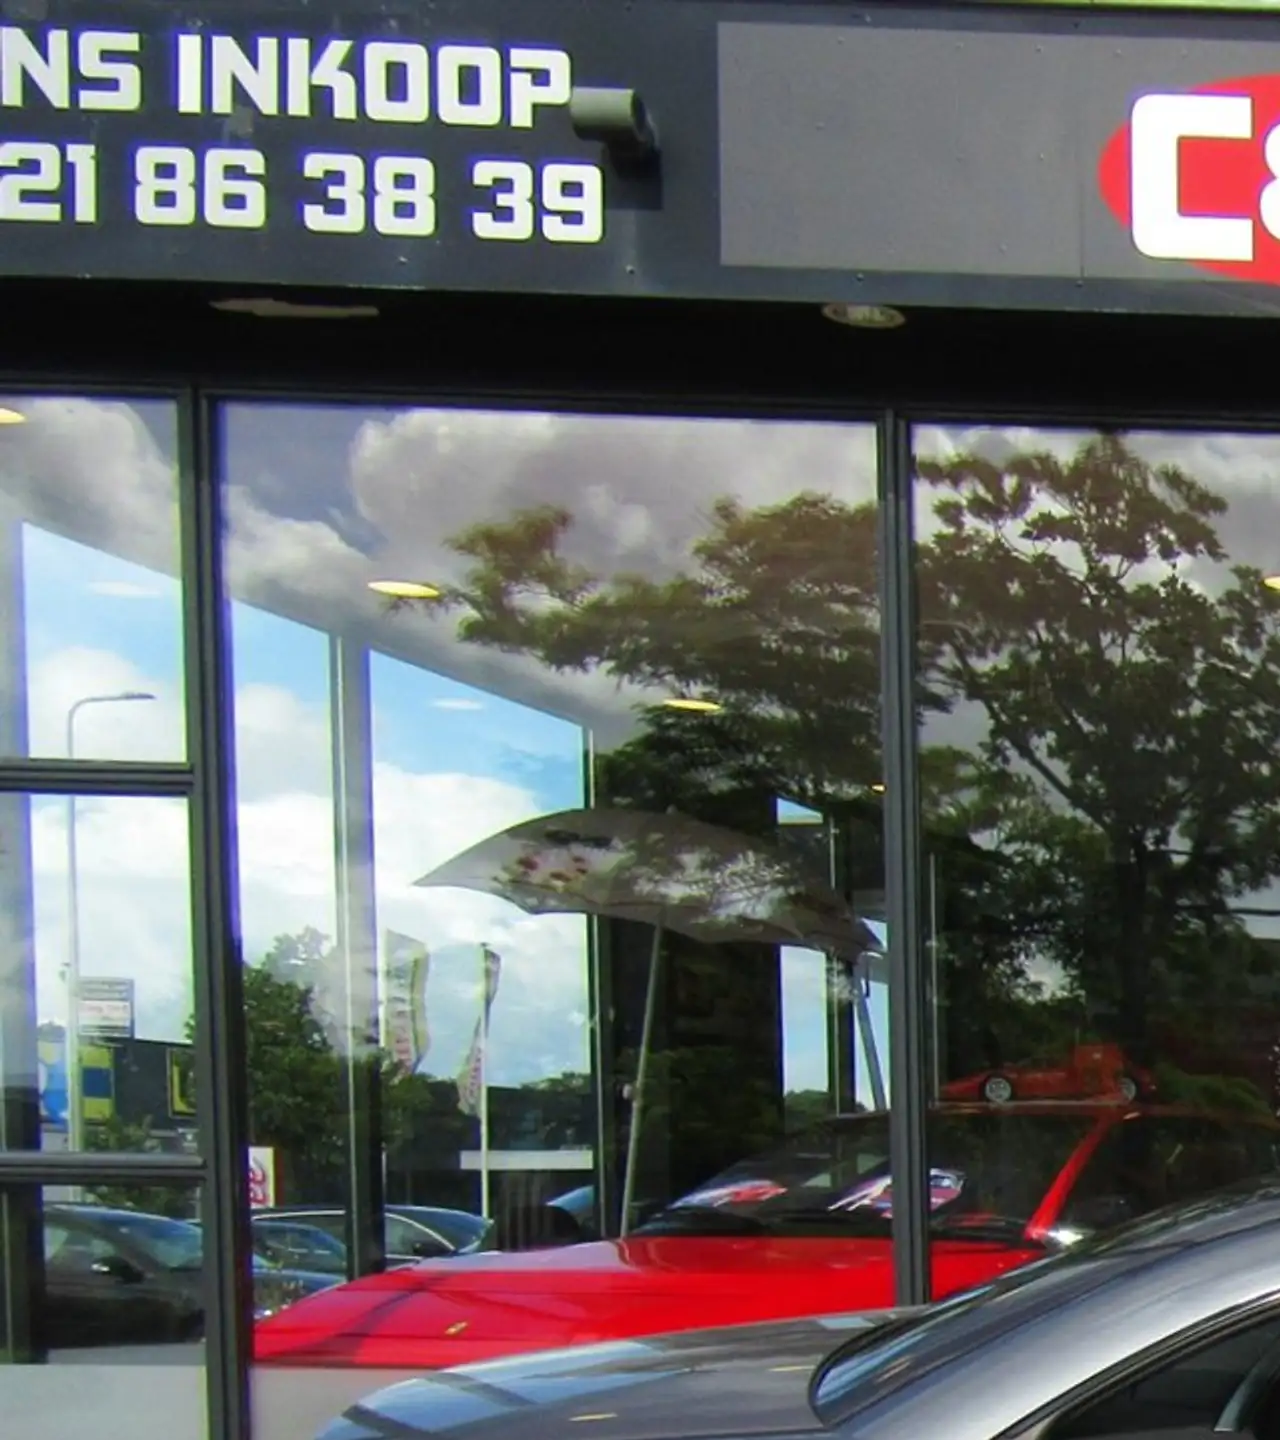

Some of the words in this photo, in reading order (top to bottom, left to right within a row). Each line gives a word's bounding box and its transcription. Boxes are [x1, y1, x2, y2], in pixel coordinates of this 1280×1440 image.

[0, 26, 140, 111] NS
[177, 33, 572, 128] INKOOP
[0, 142, 97, 222] 21
[134, 145, 266, 227] 86
[303, 153, 436, 236] 38
[471, 159, 603, 243] 39
